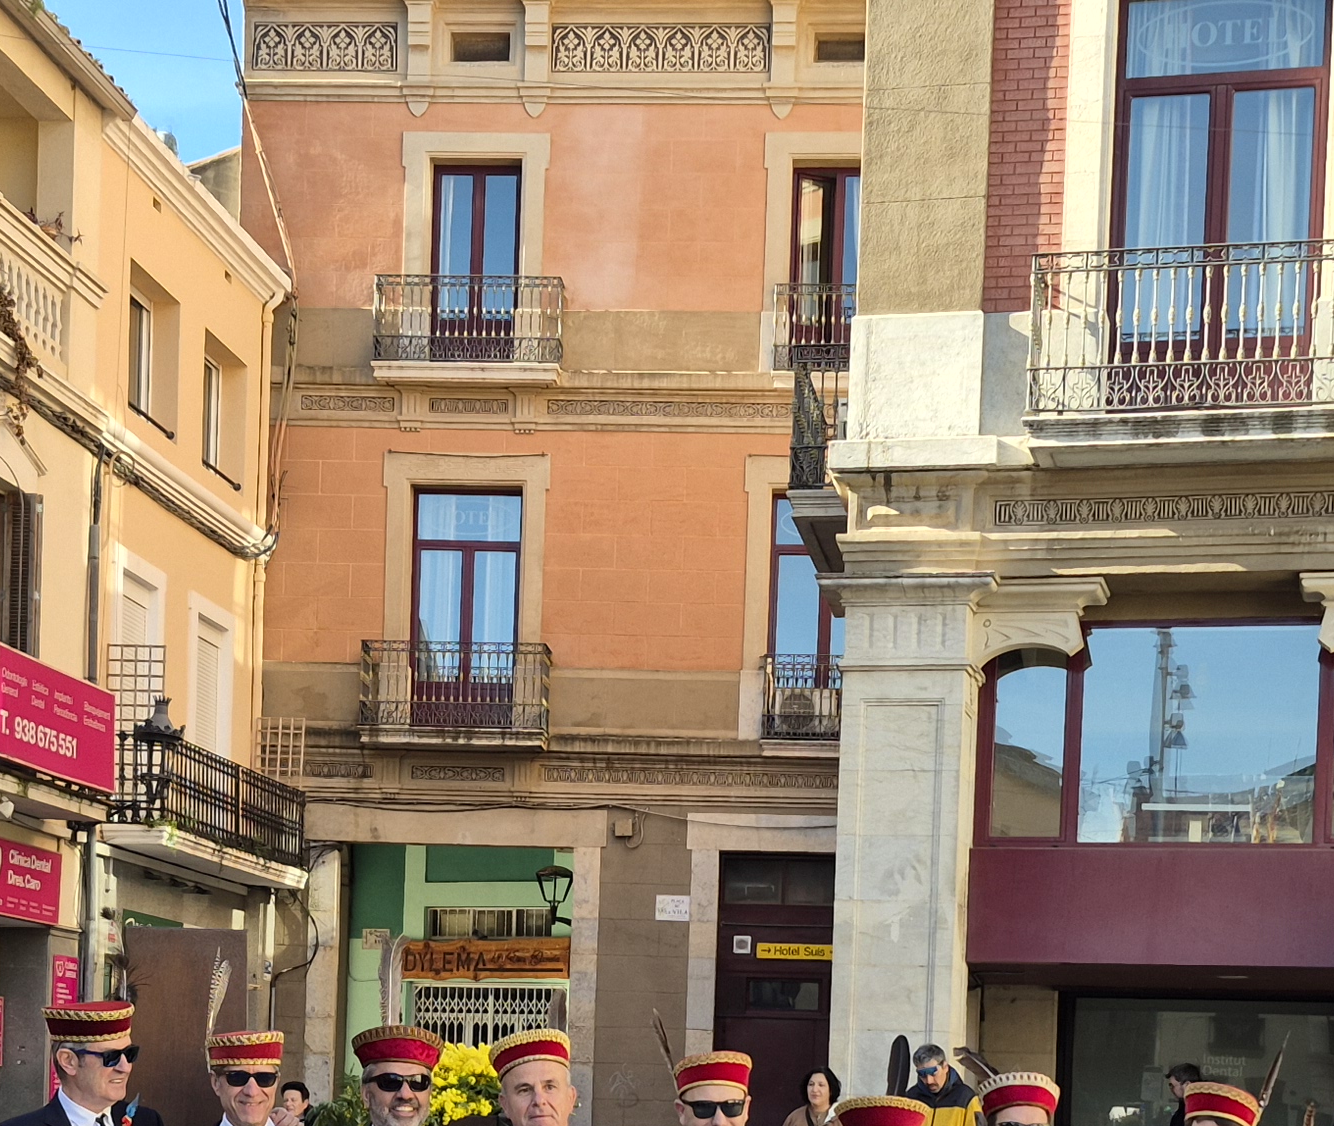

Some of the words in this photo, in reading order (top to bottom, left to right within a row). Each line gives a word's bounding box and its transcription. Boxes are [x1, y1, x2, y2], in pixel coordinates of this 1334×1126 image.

[0, 709, 10, 735] T.
[774, 945, 800, 956] Hotel
[403, 951, 487, 973] DYLEMA
[1203, 1053, 1247, 1066] Institut
[1202, 1065, 1244, 1077] Dental
